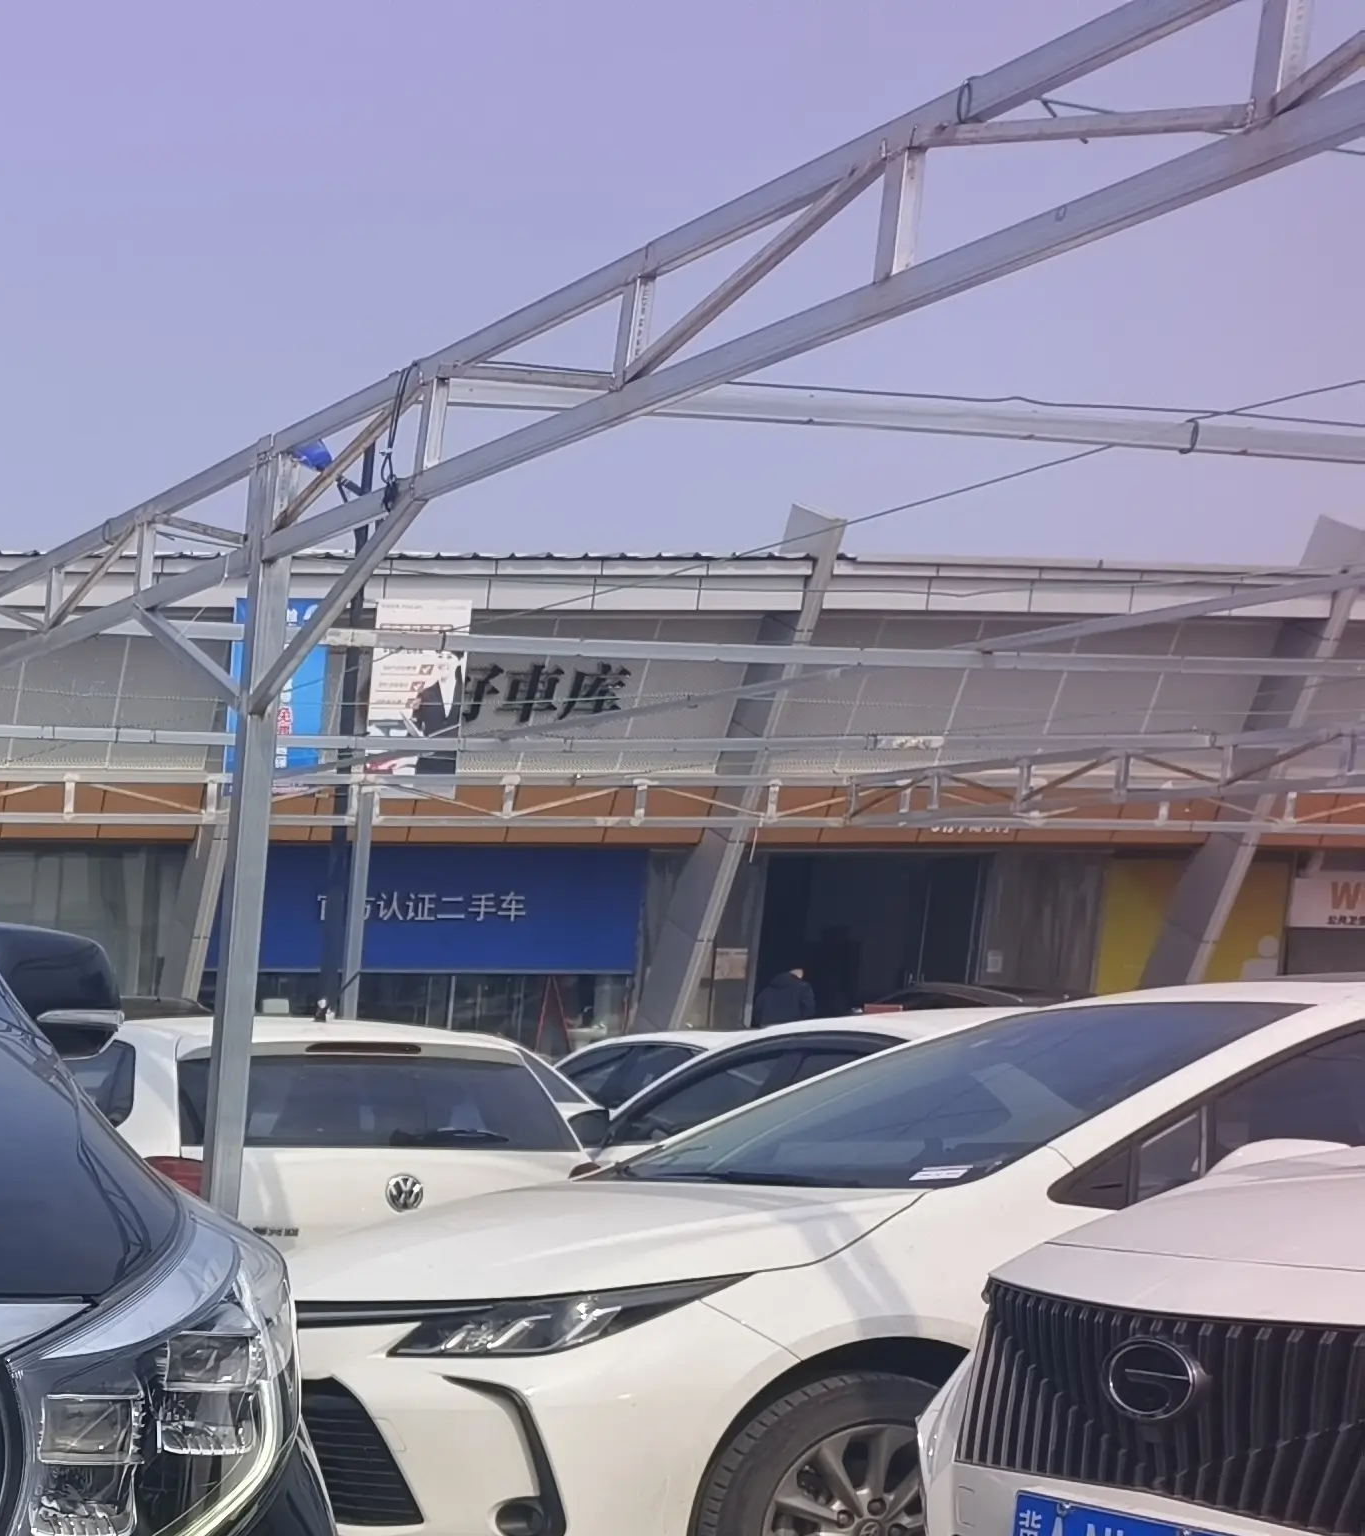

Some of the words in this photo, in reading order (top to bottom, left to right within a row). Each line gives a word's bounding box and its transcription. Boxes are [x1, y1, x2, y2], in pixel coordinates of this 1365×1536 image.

[317, 891, 527, 922] 认证二手车
[1331, 881, 1365, 911] W
